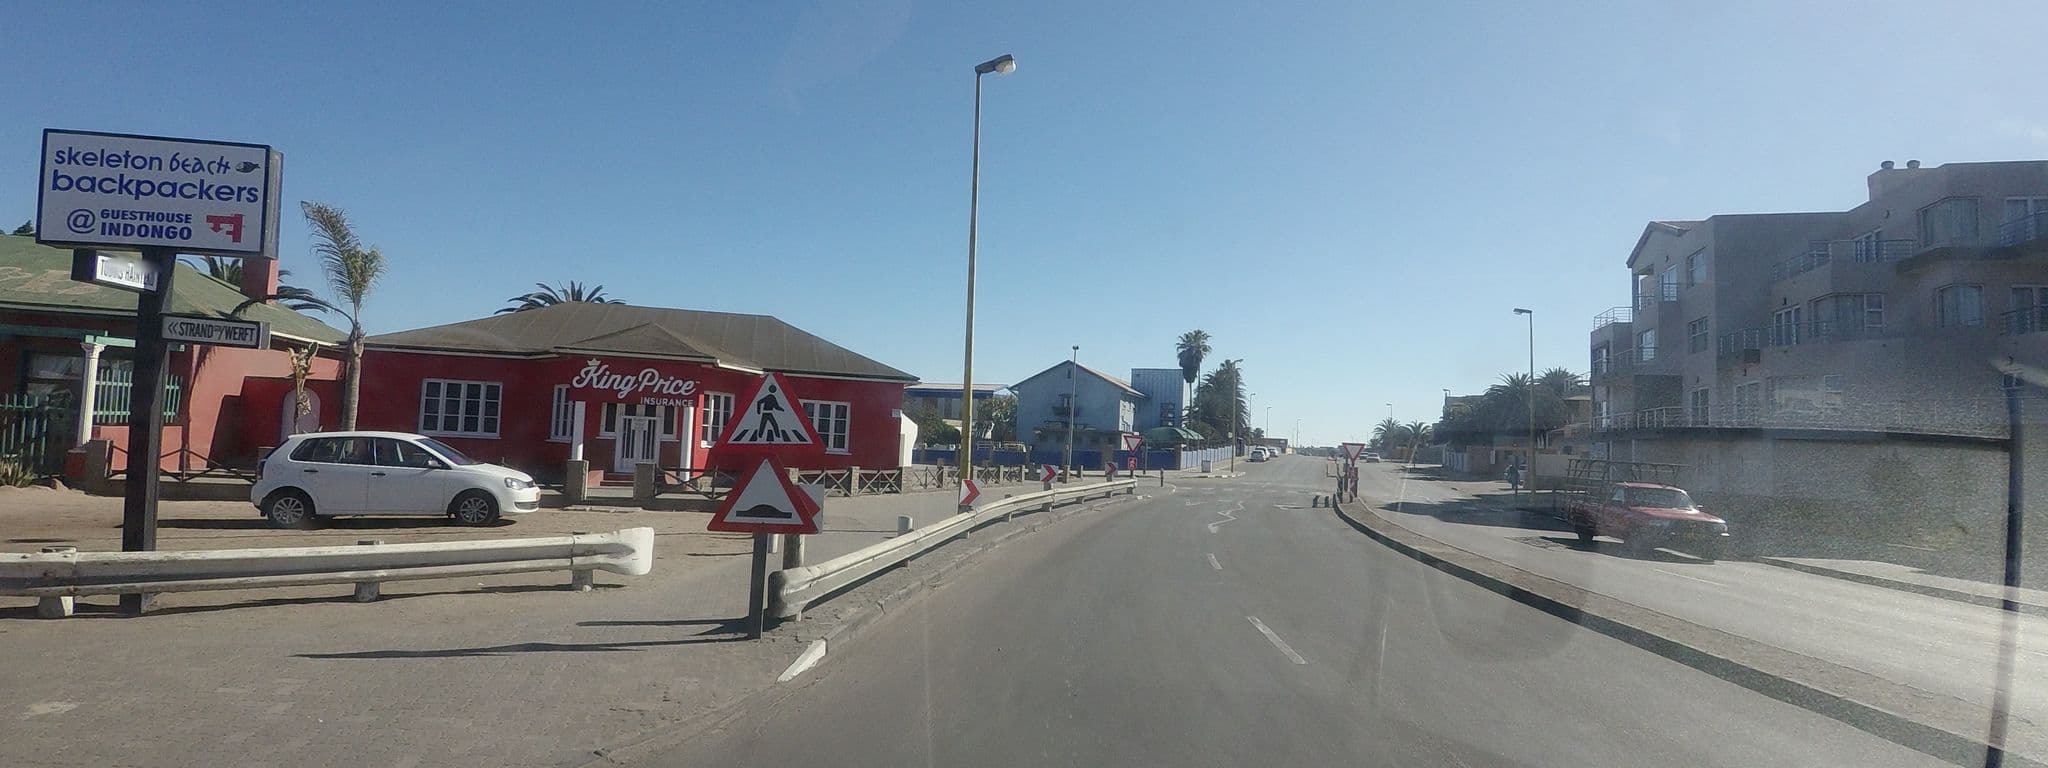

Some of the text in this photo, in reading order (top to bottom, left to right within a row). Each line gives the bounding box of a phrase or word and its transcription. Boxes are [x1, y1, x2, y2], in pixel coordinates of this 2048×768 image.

[54, 147, 163, 172] skeleton
[51, 169, 259, 203] backpackers
[67, 208, 193, 234] @ GUESTHOUSE
[100, 222, 193, 240] INDONGO
[178, 322, 214, 338] STRAND
[572, 364, 696, 399] King Price
[640, 397, 694, 407] INSURANCE
